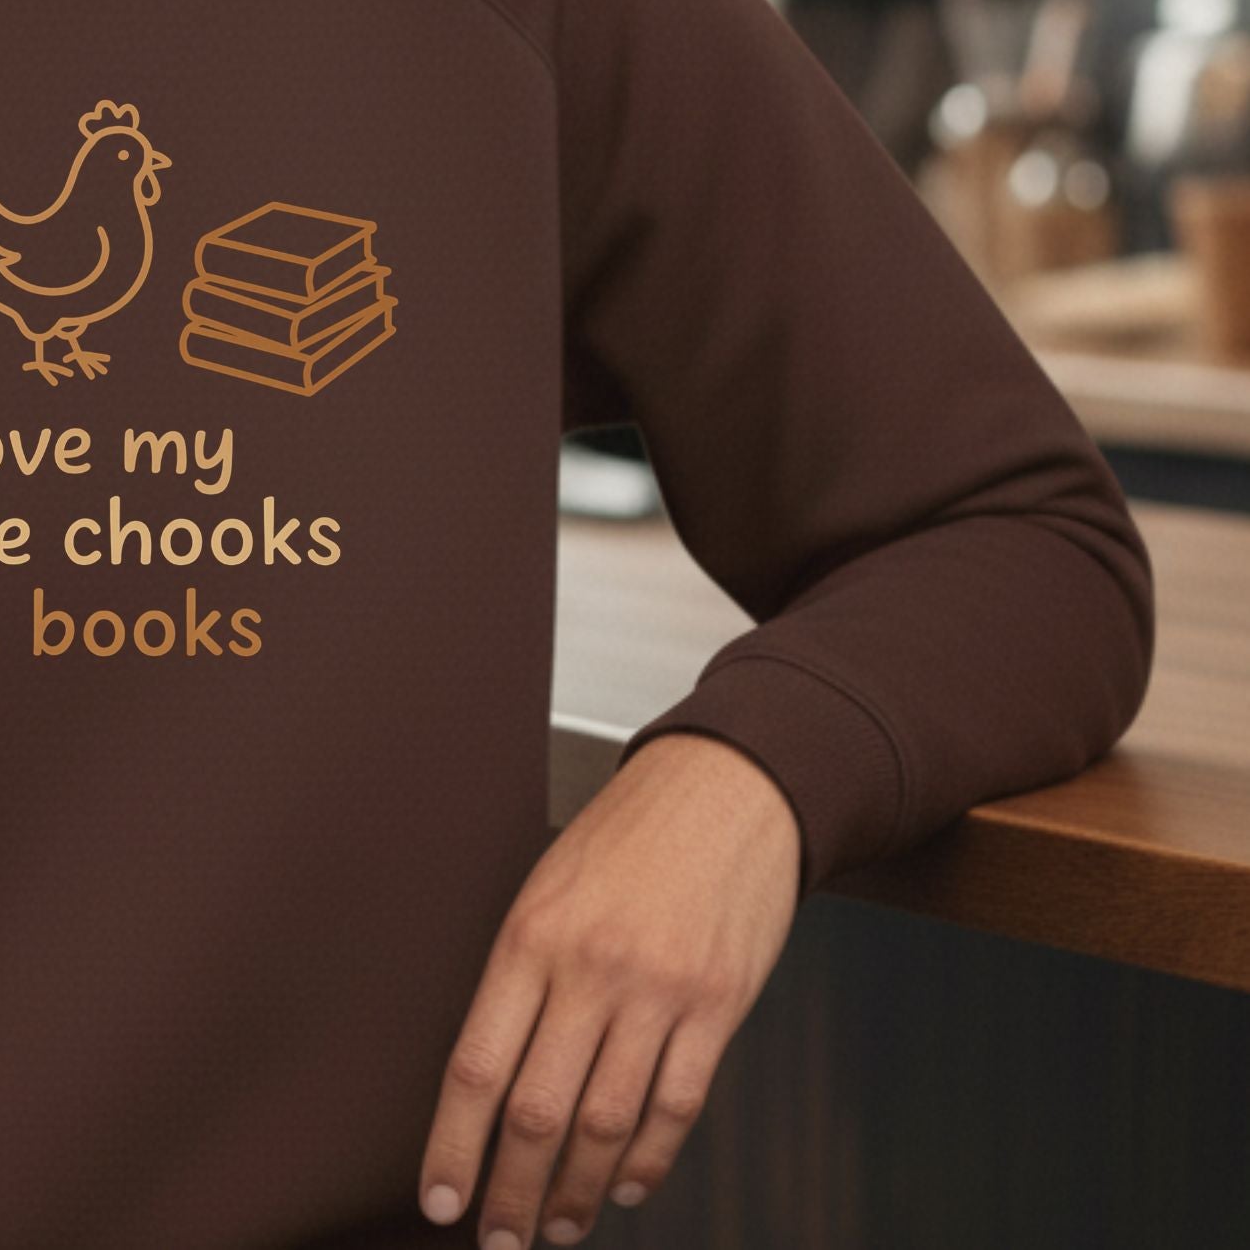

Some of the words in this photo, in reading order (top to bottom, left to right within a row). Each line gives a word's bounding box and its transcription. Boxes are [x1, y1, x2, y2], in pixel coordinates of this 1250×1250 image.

[123, 428, 234, 496] my
[63, 495, 342, 567] chooks
[32, 587, 263, 657] books
